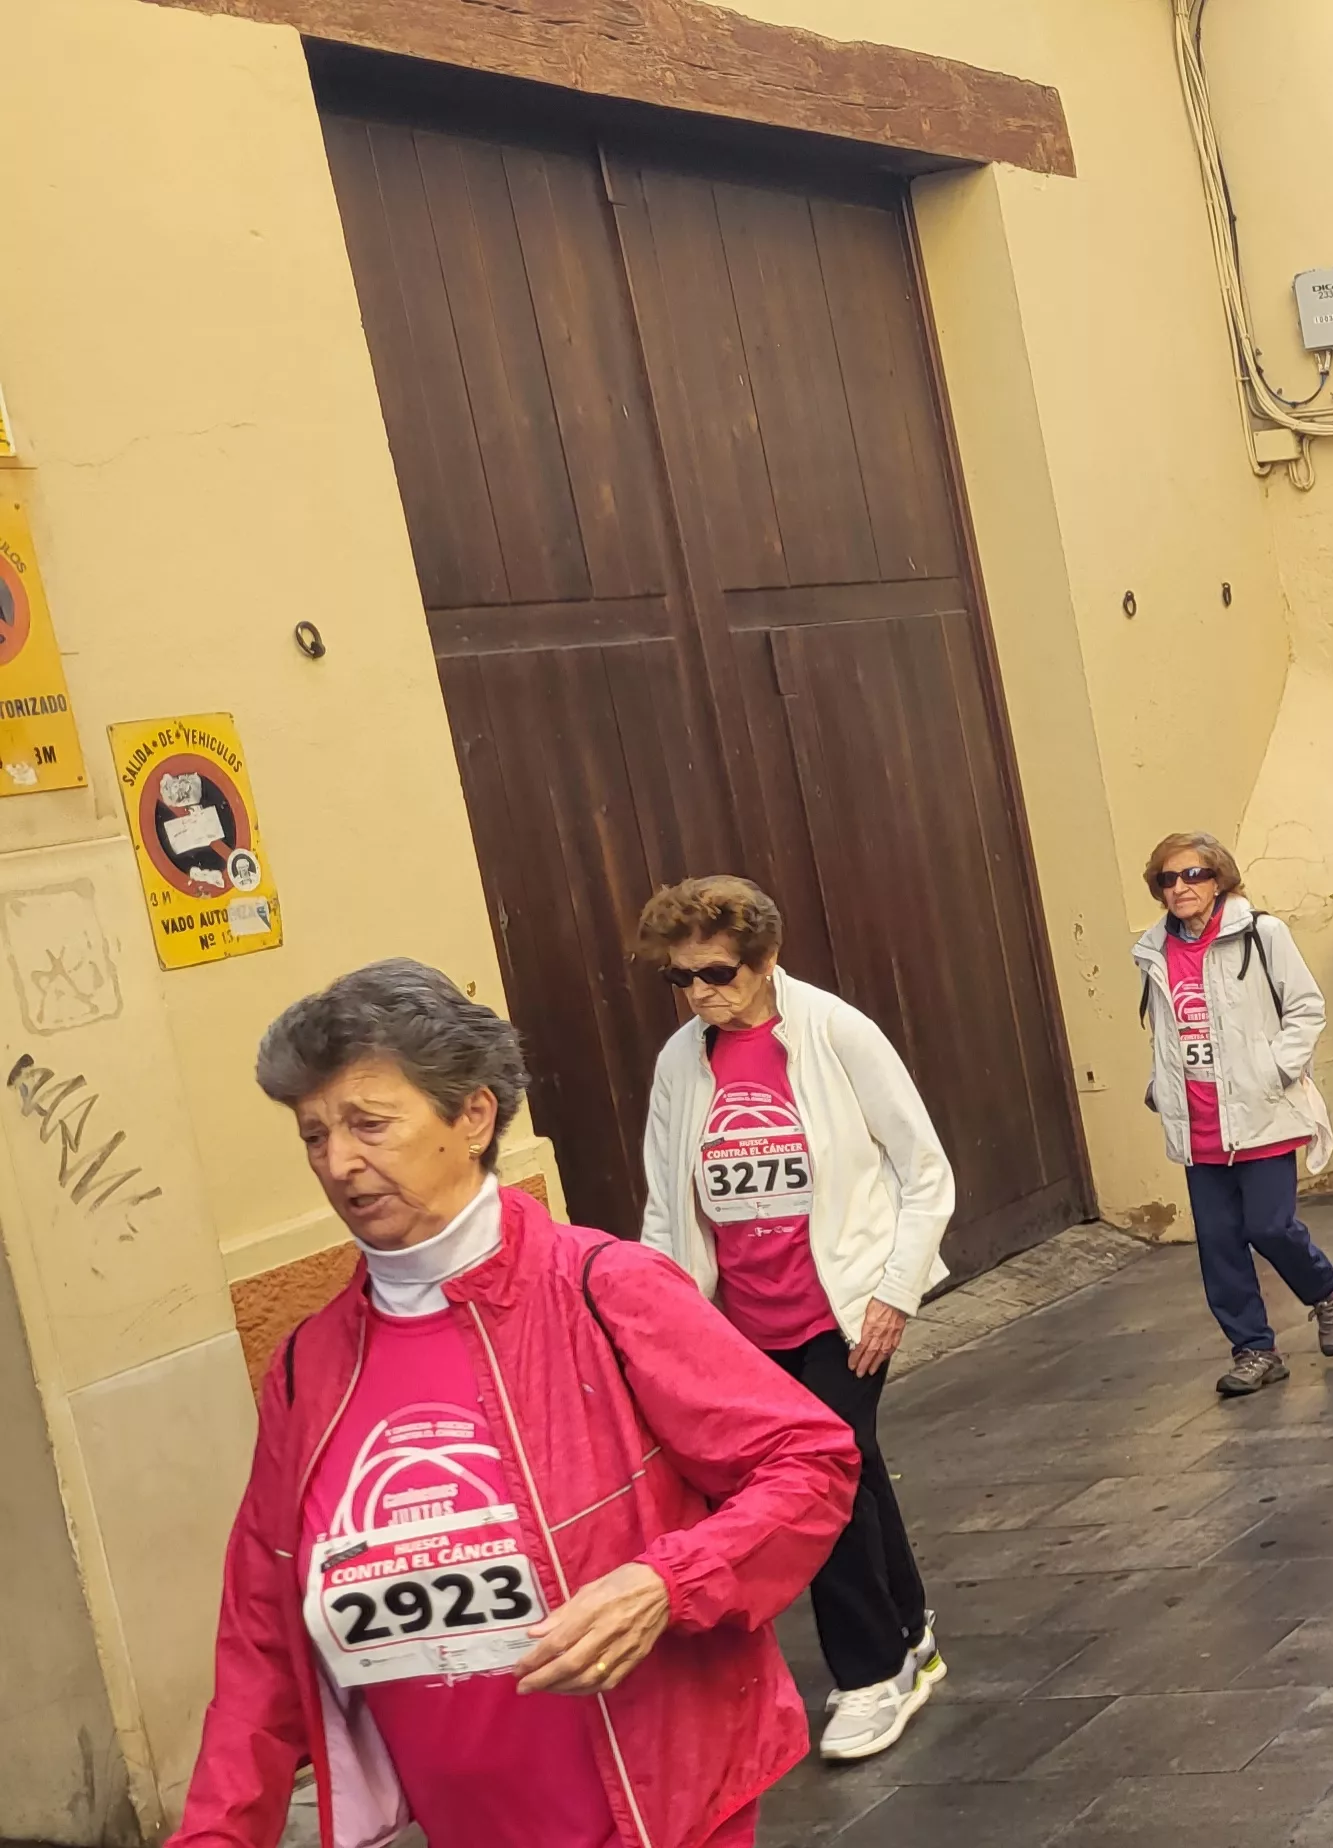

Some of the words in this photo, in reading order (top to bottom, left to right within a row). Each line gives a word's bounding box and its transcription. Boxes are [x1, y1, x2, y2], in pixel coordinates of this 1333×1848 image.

[1319, 290, 1333, 299] 233
[122, 743, 154, 787] SALIDA
[159, 728, 175, 749] DE
[184, 728, 243, 774] VEHICULOS
[161, 912, 195, 935] VADO
[707, 1149, 748, 1159] CONTRA
[749, 1147, 762, 1155] EL
[763, 1142, 803, 1154] CÁNCER
[739, 1138, 769, 1147] HUESCA
[708, 1157, 808, 1196] 3275
[394, 1536, 450, 1556] HUESCA
[331, 1556, 409, 1584] CONTRA
[412, 1553, 433, 1568] EL
[439, 1538, 518, 1564] CÁNCER
[331, 1565, 532, 1645] 2923
